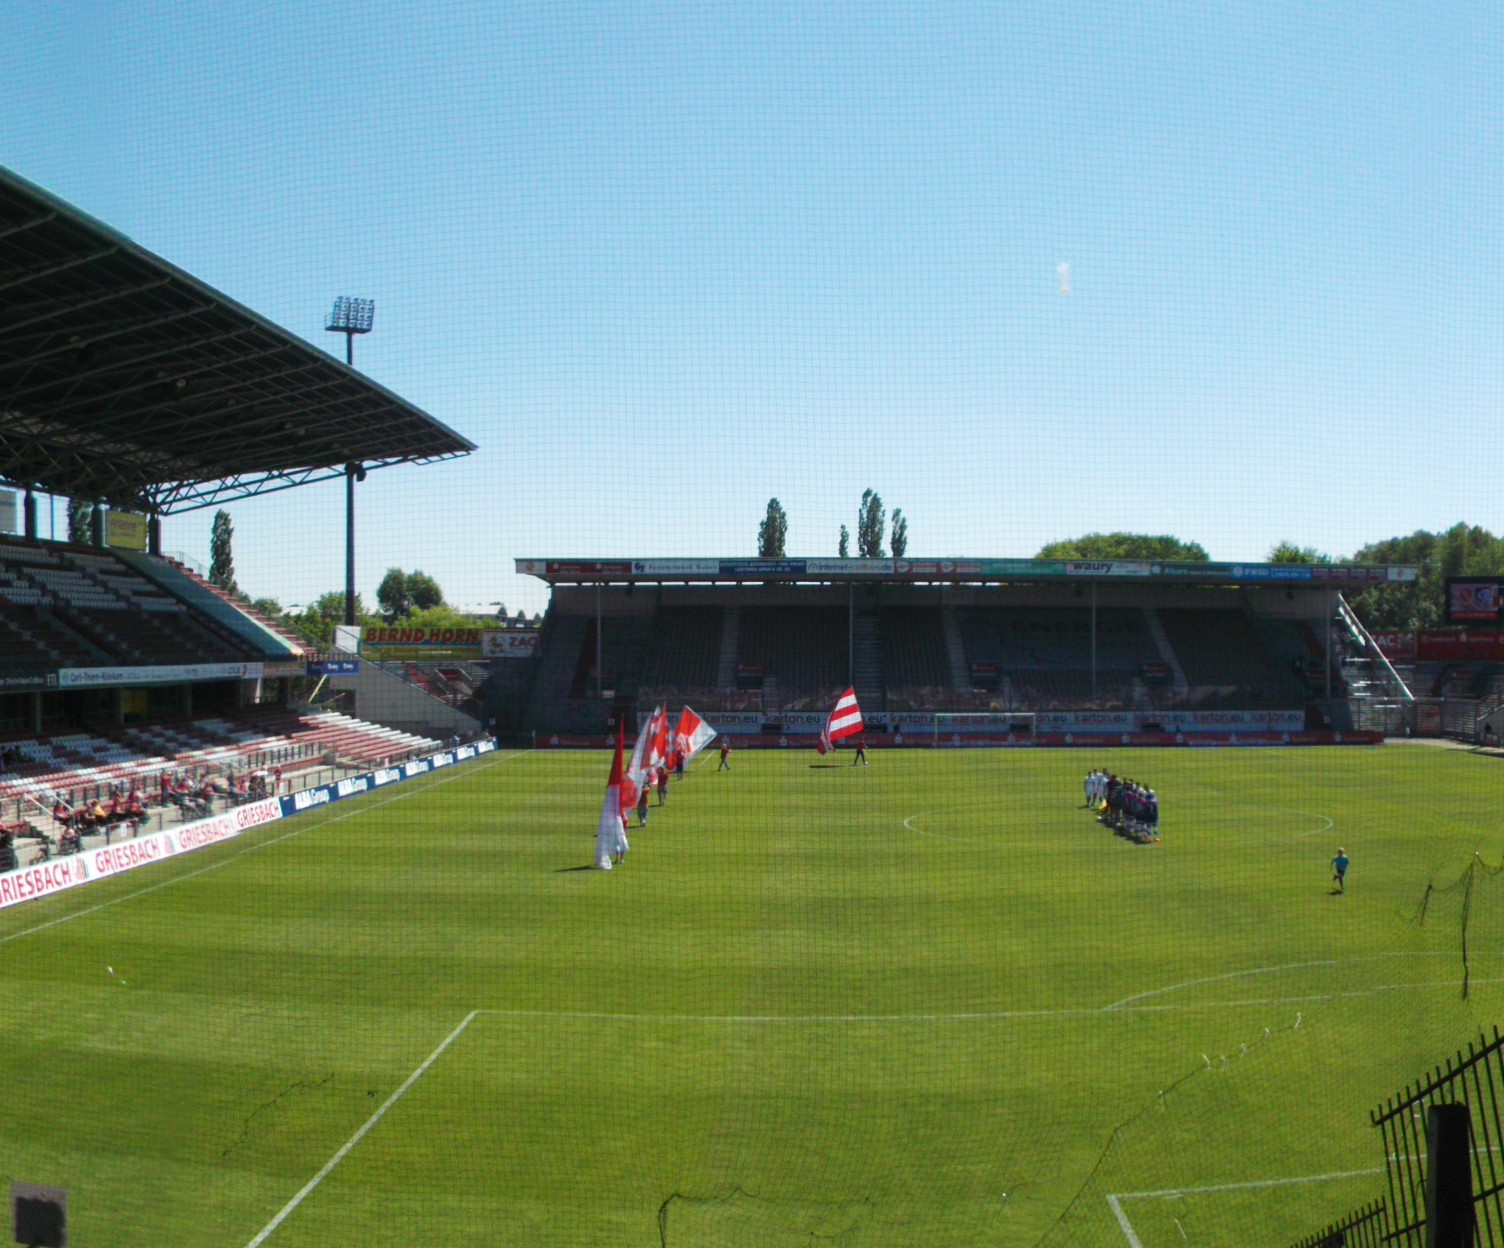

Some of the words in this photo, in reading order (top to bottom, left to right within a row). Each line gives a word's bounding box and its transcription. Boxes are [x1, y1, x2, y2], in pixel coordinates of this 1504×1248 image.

[1073, 560, 1114, 575] waury
[366, 626, 425, 644] BERND
[429, 627, 479, 643] HORN
[703, 713, 758, 724] karton.eu
[766, 713, 820, 724] karton.eu
[236, 799, 281, 828] GRIESBACH
[178, 817, 233, 850] GRIESBACH
[95, 838, 160, 873] GRIESBACH
